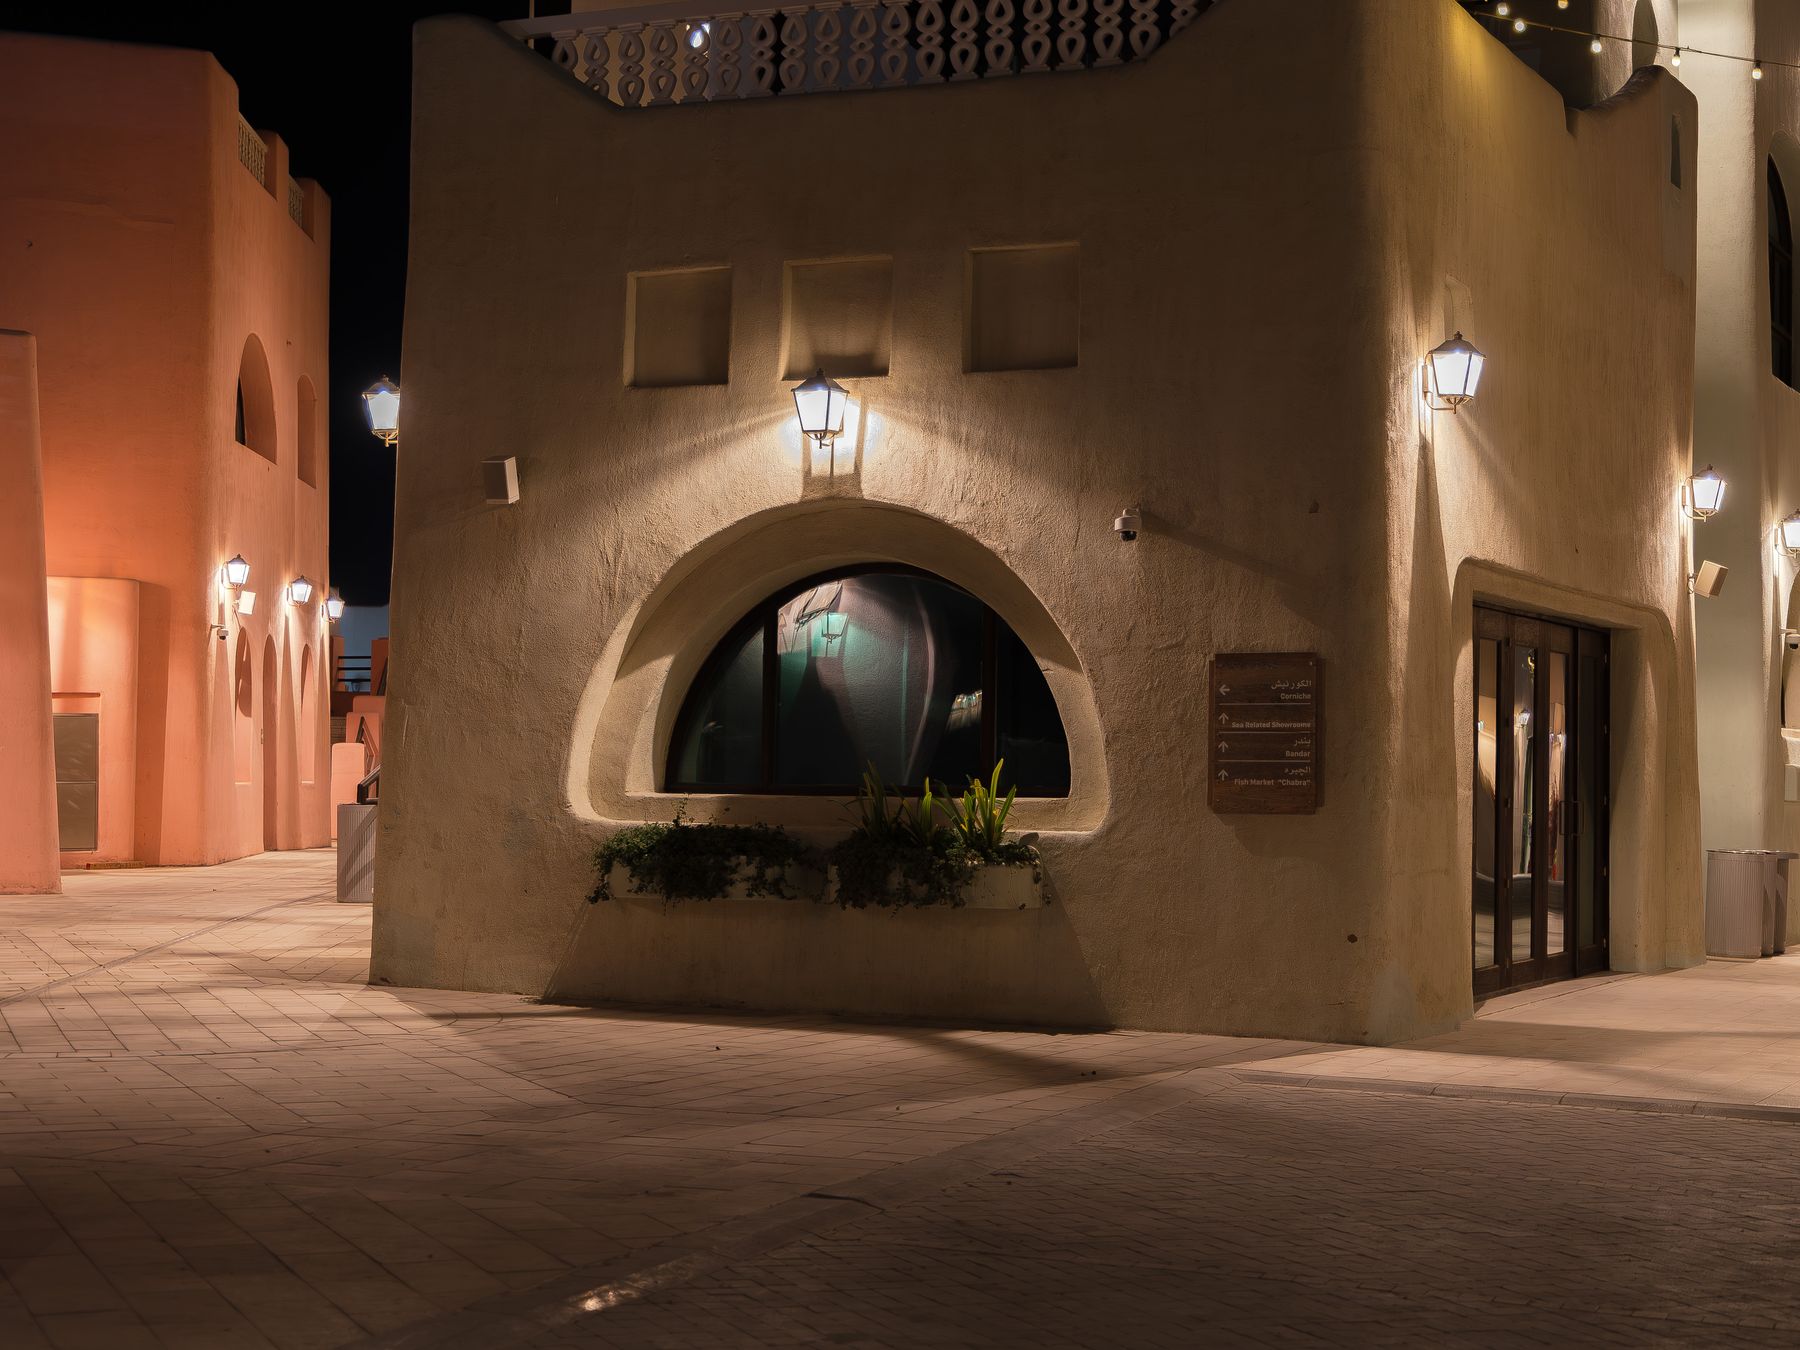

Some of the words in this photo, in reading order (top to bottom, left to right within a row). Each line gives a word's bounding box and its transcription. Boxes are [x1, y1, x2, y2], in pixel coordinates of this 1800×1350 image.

[1280, 692, 1311, 700] Corniche
[1232, 721, 1244, 729] Sea
[1245, 721, 1270, 729] Related
[1272, 721, 1311, 729] Showrooms
[1286, 750, 1311, 758] Bandar
[1234, 778, 1249, 786] Fish
[1250, 779, 1274, 787] Market
